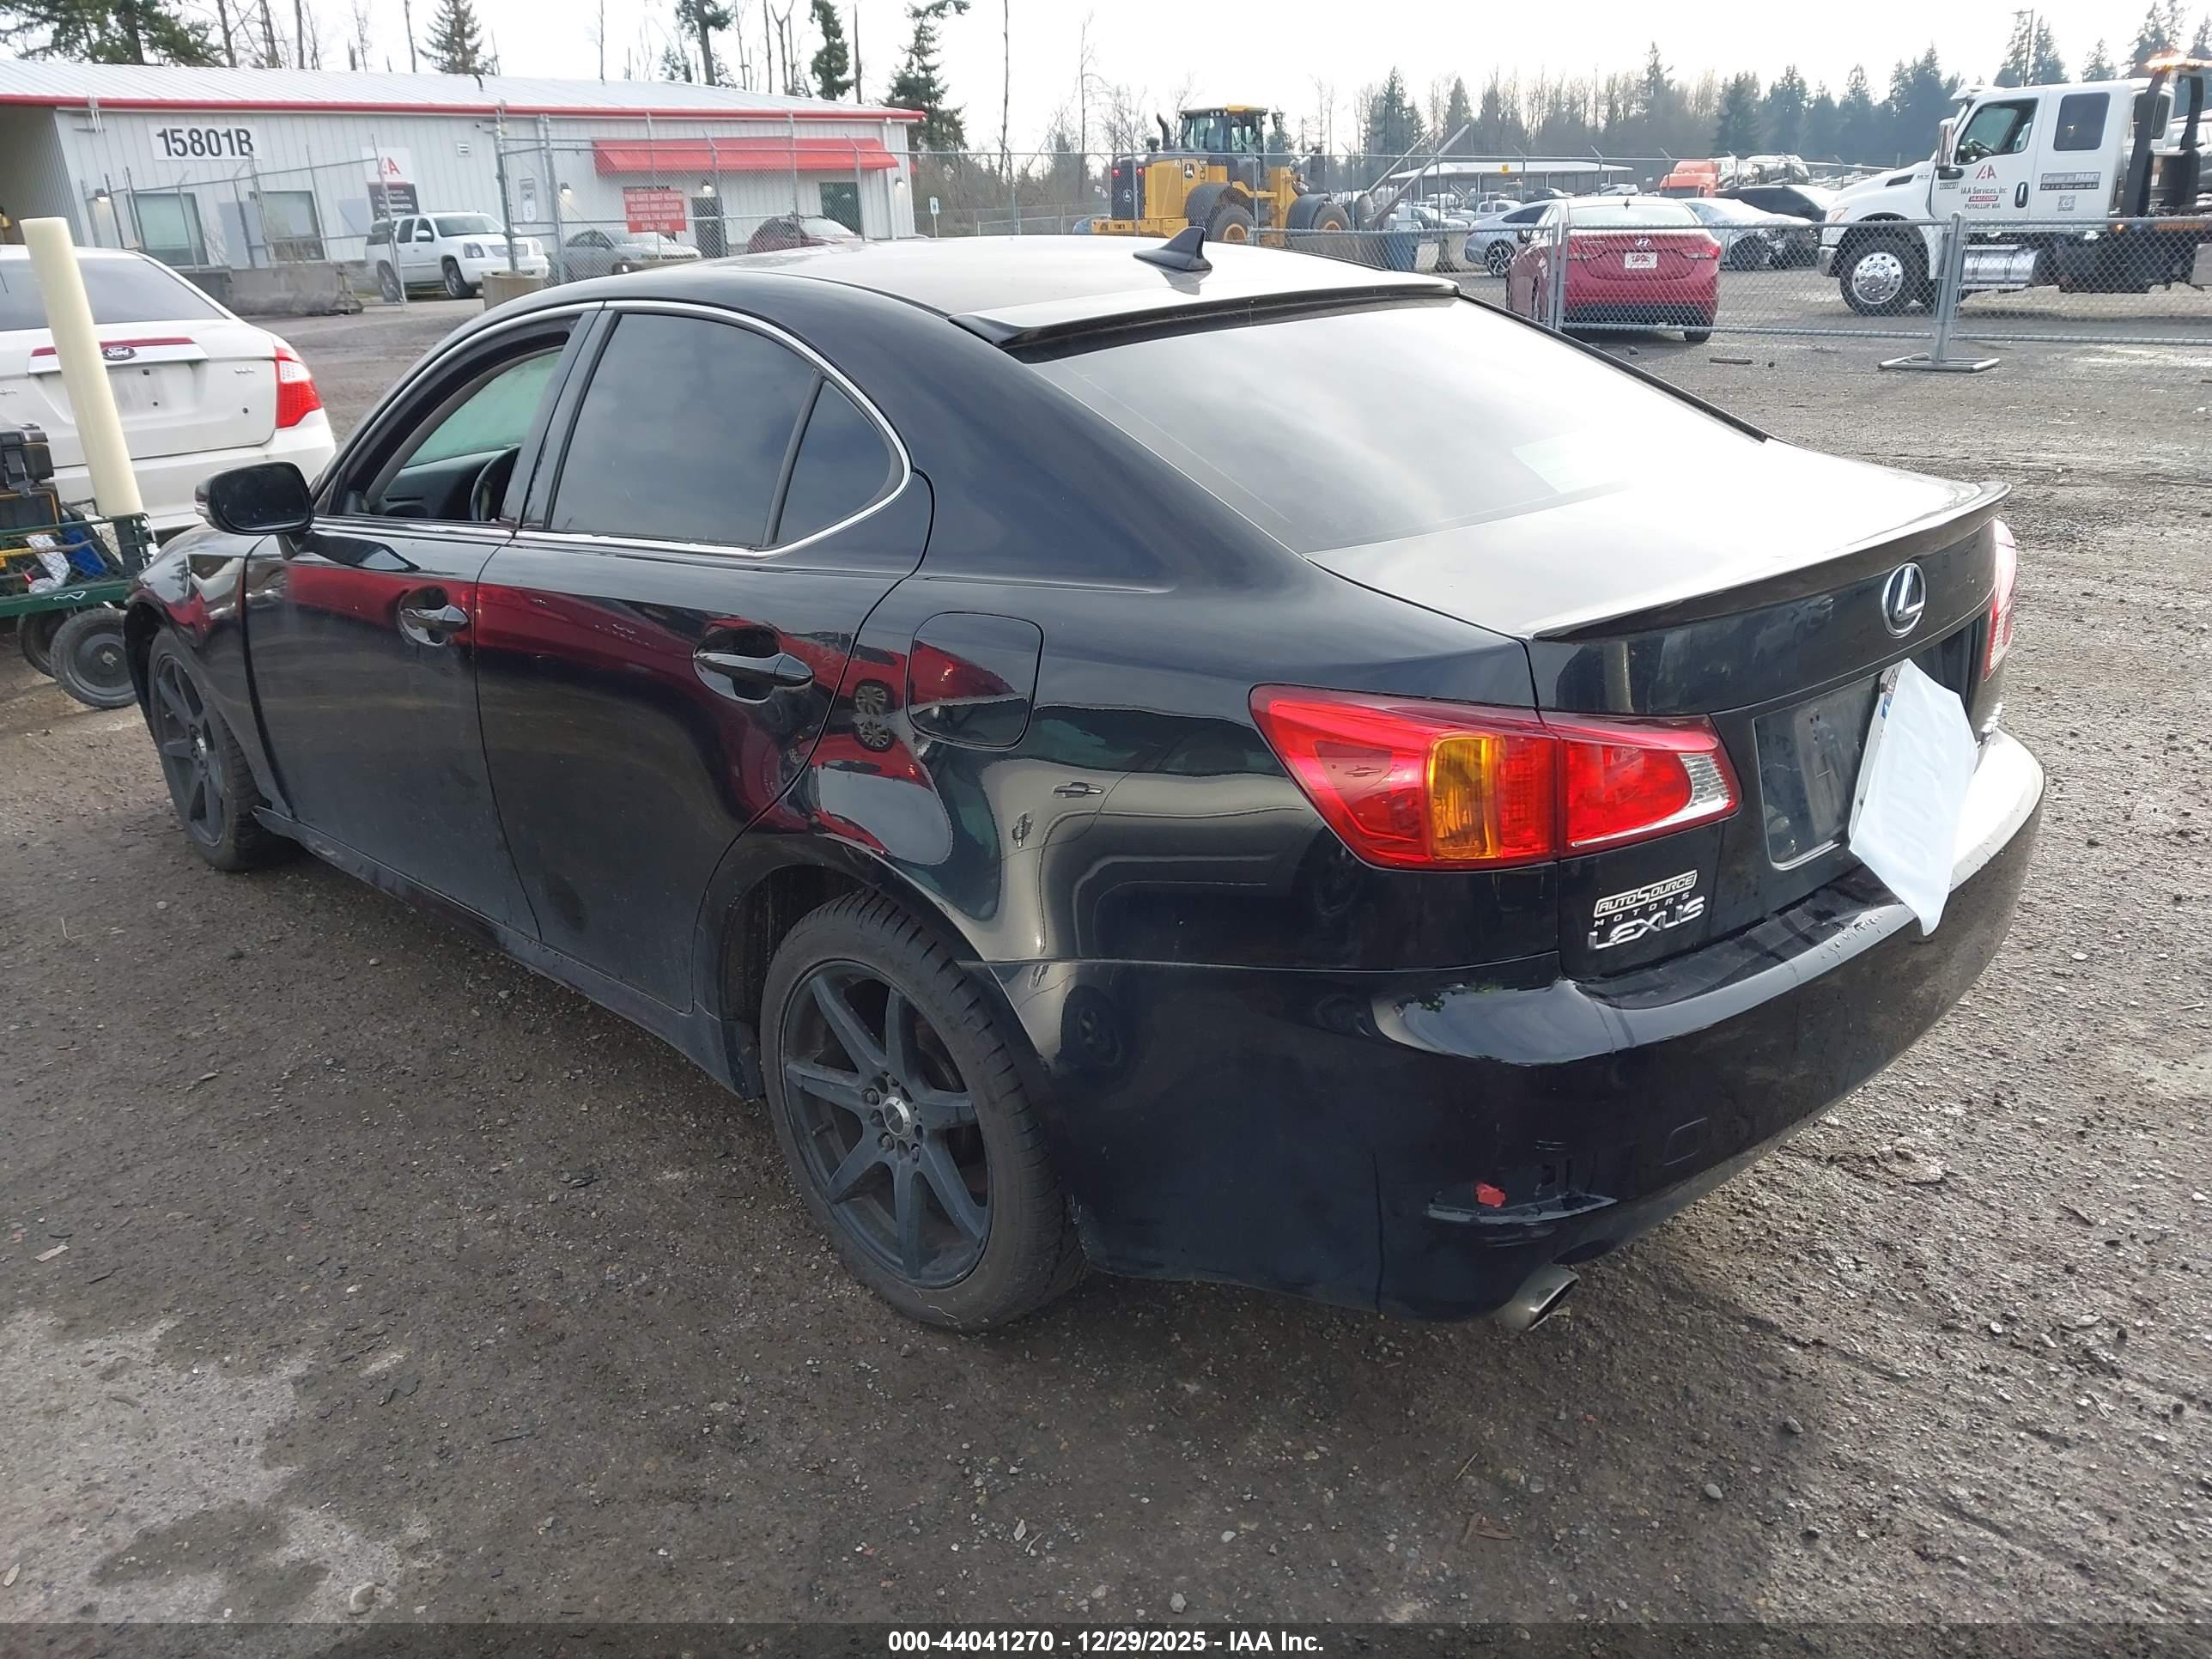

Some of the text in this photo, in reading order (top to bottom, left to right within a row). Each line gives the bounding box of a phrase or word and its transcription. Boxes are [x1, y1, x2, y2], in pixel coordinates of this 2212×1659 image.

[156, 128, 253, 156] 15801B
[106, 346, 130, 357] Ford
[1589, 896, 1705, 950] LEXUS
[1594, 891, 1690, 927] MOTORS
